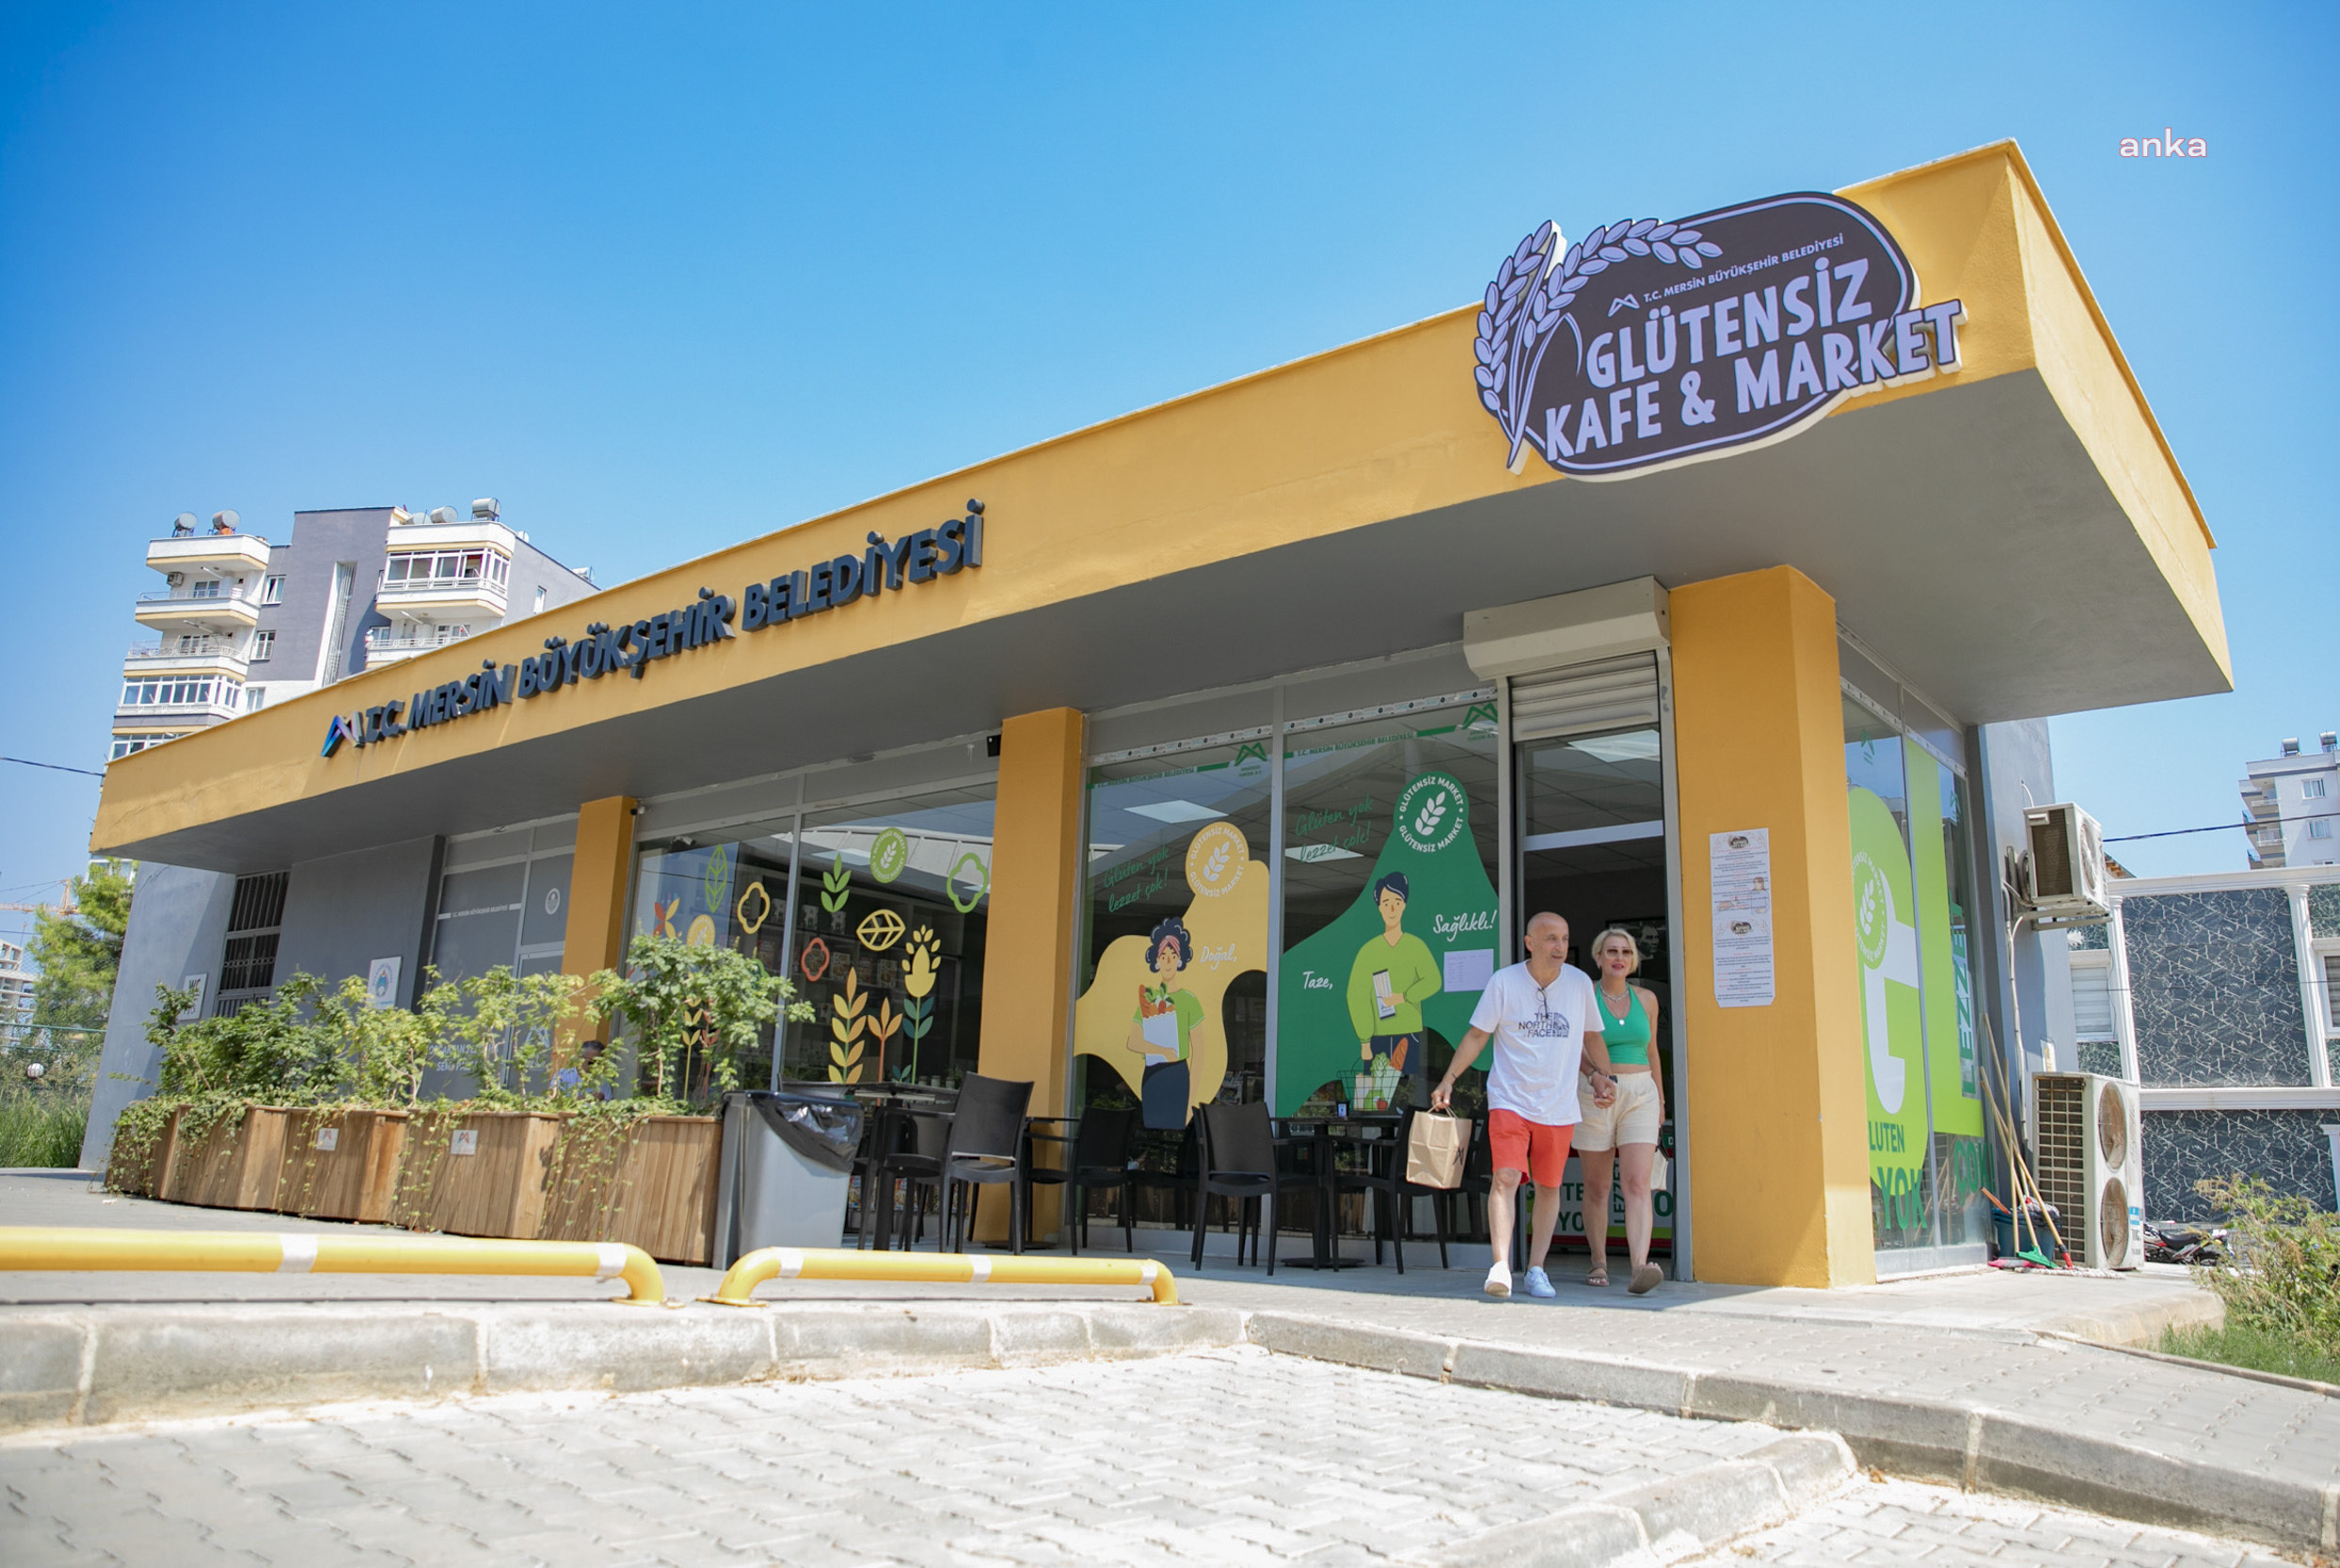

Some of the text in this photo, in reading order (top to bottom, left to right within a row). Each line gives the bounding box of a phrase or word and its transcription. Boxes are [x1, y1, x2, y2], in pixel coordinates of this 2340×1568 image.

[1644, 233, 1844, 303] T.C. MERSİN BÜYÜKŞEHİR BELEDİYESİ
[1586, 257, 1872, 388] GLÜTENSİZ
[1545, 299, 1964, 462] KAFE & MARKET
[407, 659, 517, 731] MERSİN
[517, 586, 736, 699] BÜYÜKŞEHİR
[742, 499, 985, 633] BELEDİYESİ
[1399, 775, 1464, 812] GLÜTENSİZ MARKET
[1295, 792, 1374, 837] Glüten yok
[1190, 827, 1245, 861] GLÜTENSİZ MARKET
[1399, 816, 1464, 853] GLÜTENSİZ MARKET
[1148, 844, 1170, 876] yok
[1108, 867, 1170, 913] lezzet çok!
[1221, 864, 1245, 895] MARKET
[1433, 910, 1498, 942] Sağlıklı!
[1200, 943, 1237, 972] Doğal,
[1302, 971, 1334, 990] Taze,
[1948, 889, 1977, 1095] LEZZET
[1519, 1021, 1552, 1030] NORTH
[1527, 1029, 1552, 1037] FACE
[1535, 1012, 1552, 1021] THE
[1868, 1120, 1905, 1153] LUTEN
[1953, 1139, 1997, 1207] ÇOK!
[1877, 1166, 1928, 1230] YOK
